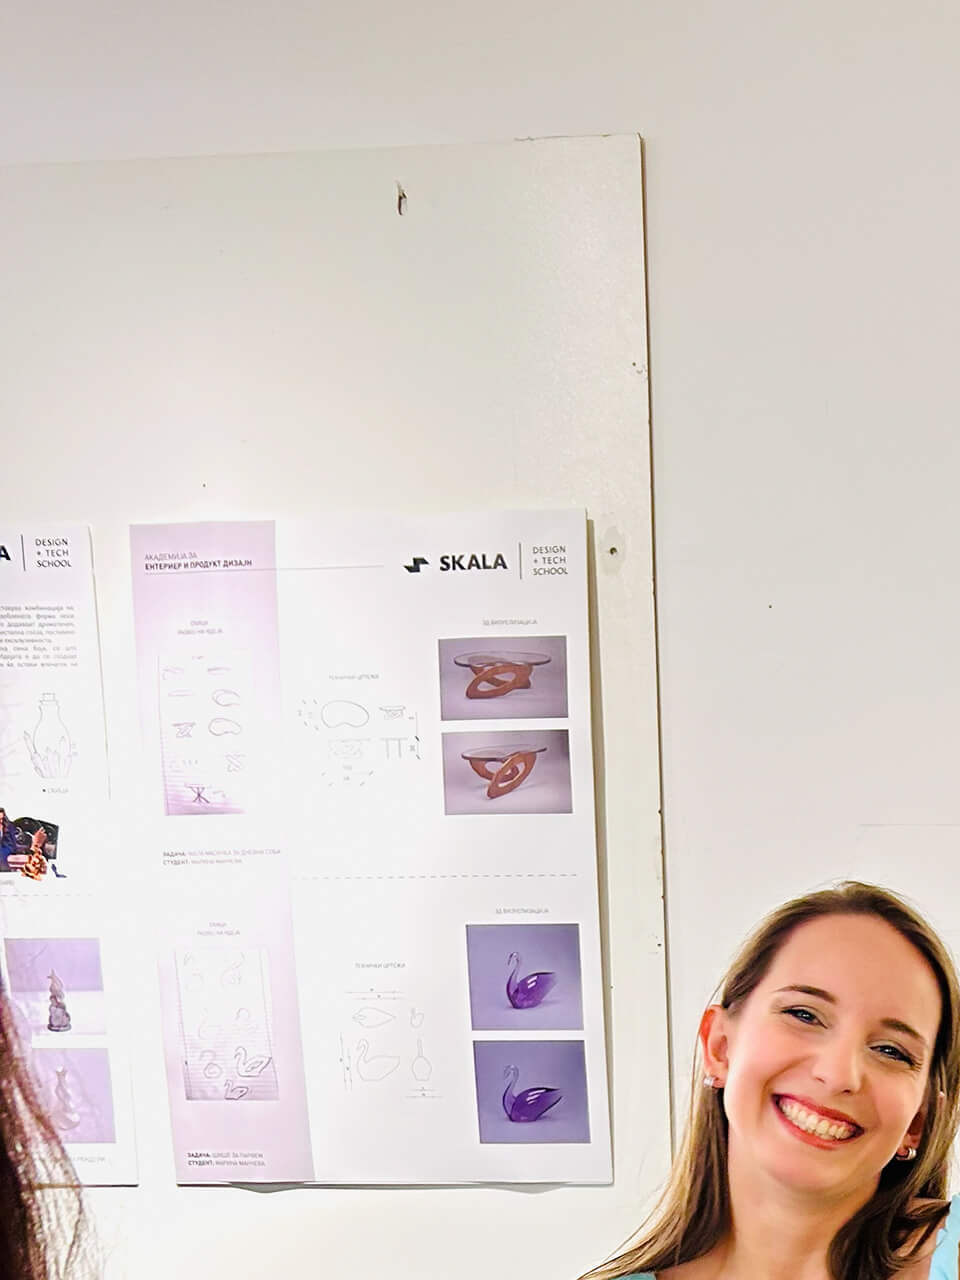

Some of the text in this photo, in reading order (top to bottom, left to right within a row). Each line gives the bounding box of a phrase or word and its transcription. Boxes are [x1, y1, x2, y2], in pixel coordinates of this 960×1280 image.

[35, 538, 68, 547] DESIGN
[46, 549, 69, 558] TECH
[533, 546, 566, 554] DESIGN
[37, 559, 72, 568] SCHOOL
[145, 562, 182, 571] ЕНТЕРИЕР
[190, 560, 221, 568] ПРОДУКТ
[223, 559, 253, 567] ДИЗАЈН
[440, 554, 508, 571] SKALA
[542, 557, 567, 565] TECH
[533, 567, 568, 576] SCHOOL
